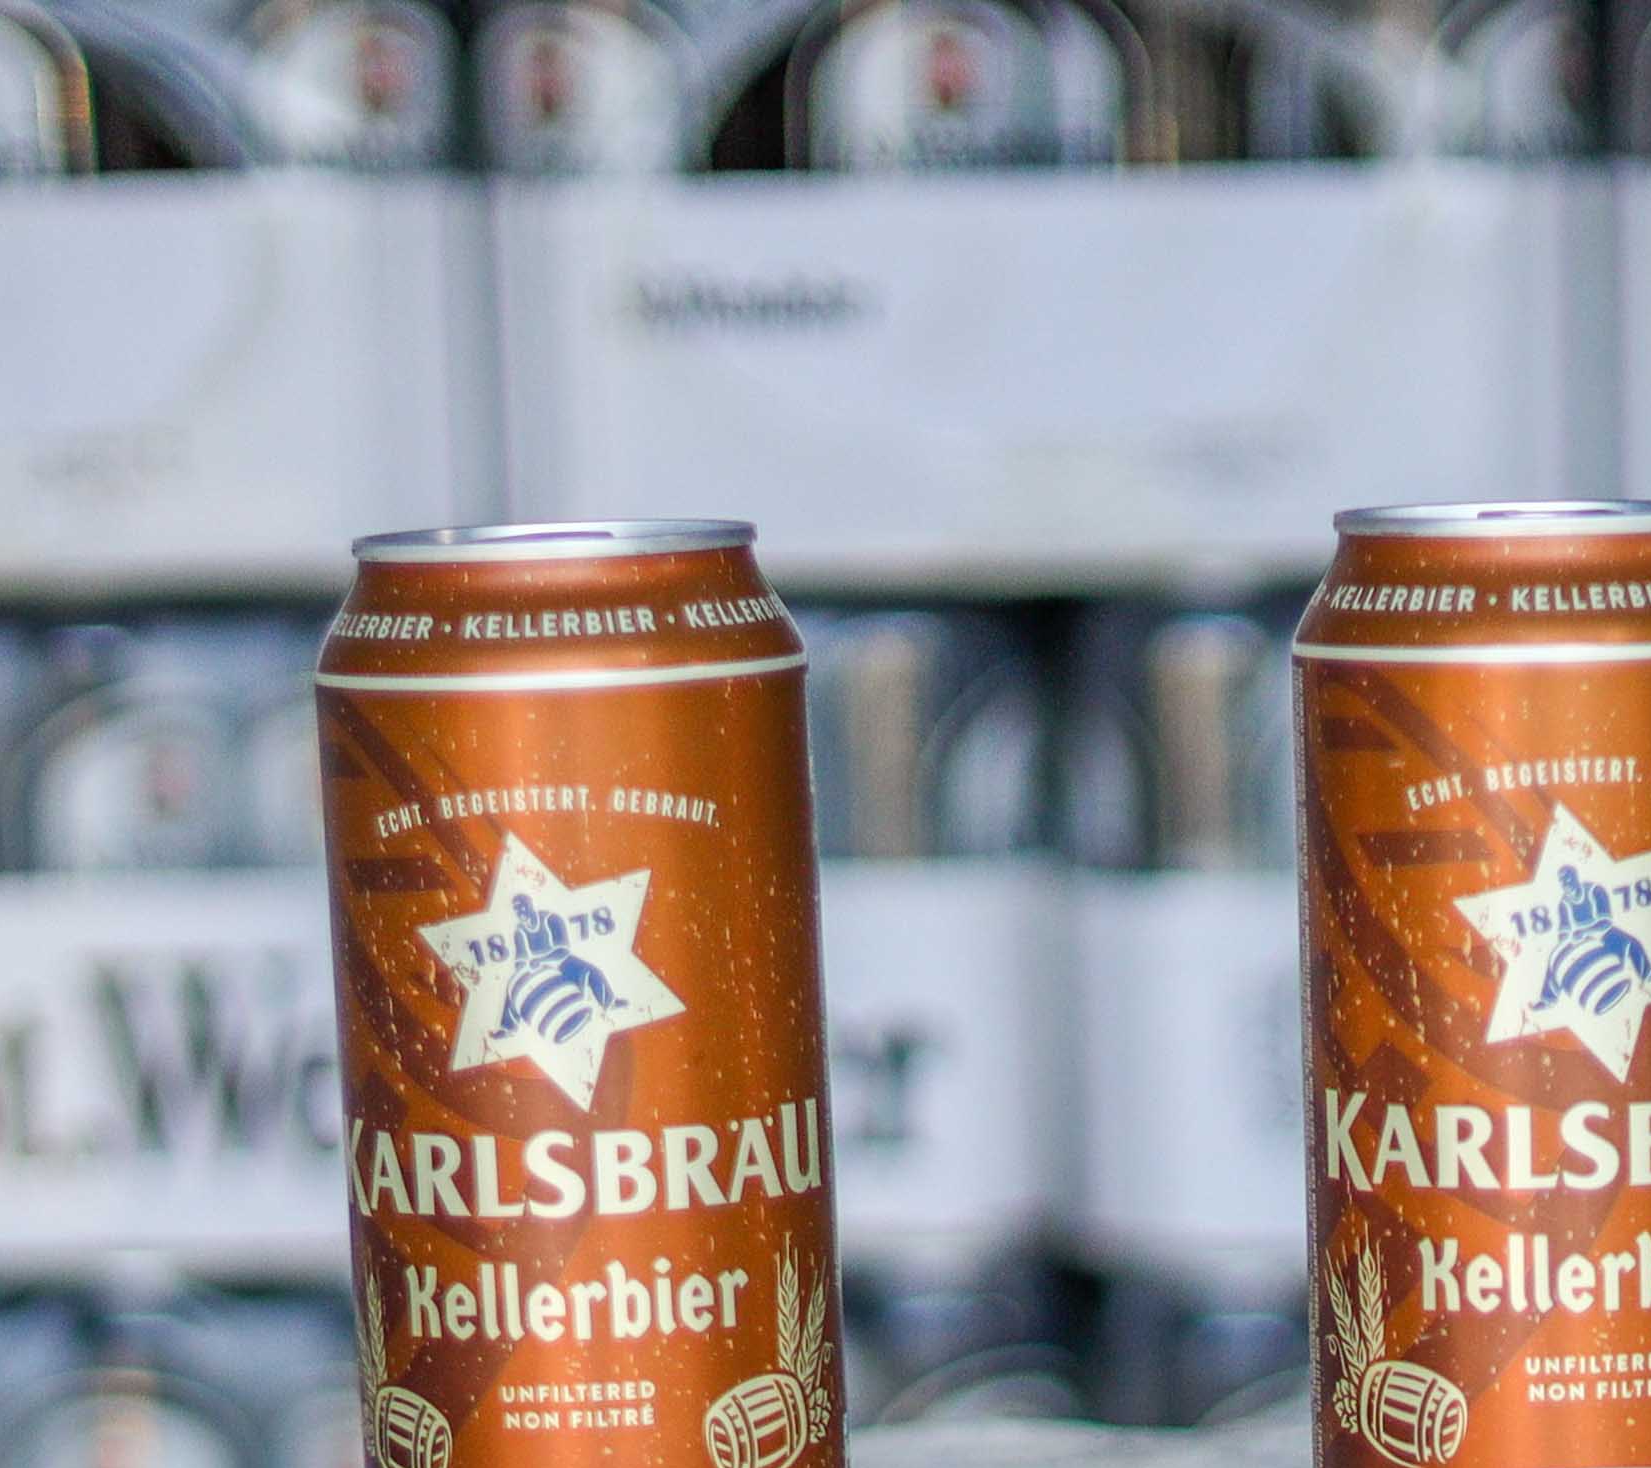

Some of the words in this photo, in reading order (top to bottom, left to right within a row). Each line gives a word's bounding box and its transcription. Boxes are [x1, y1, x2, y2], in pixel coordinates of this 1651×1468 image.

[463, 609, 655, 640] KELLERBIER
[1408, 773, 1472, 810] ECHT.
[1486, 758, 1642, 792] BEGEISTERT.
[377, 801, 429, 839] ECHT.
[442, 787, 596, 818] BEGEISTERT.
[614, 788, 719, 828] GEBRAUT.
[469, 938, 507, 967] 18
[569, 906, 614, 938] 78
[406, 1257, 747, 1341] Kellerbier
[1529, 1382, 1587, 1401] NON
